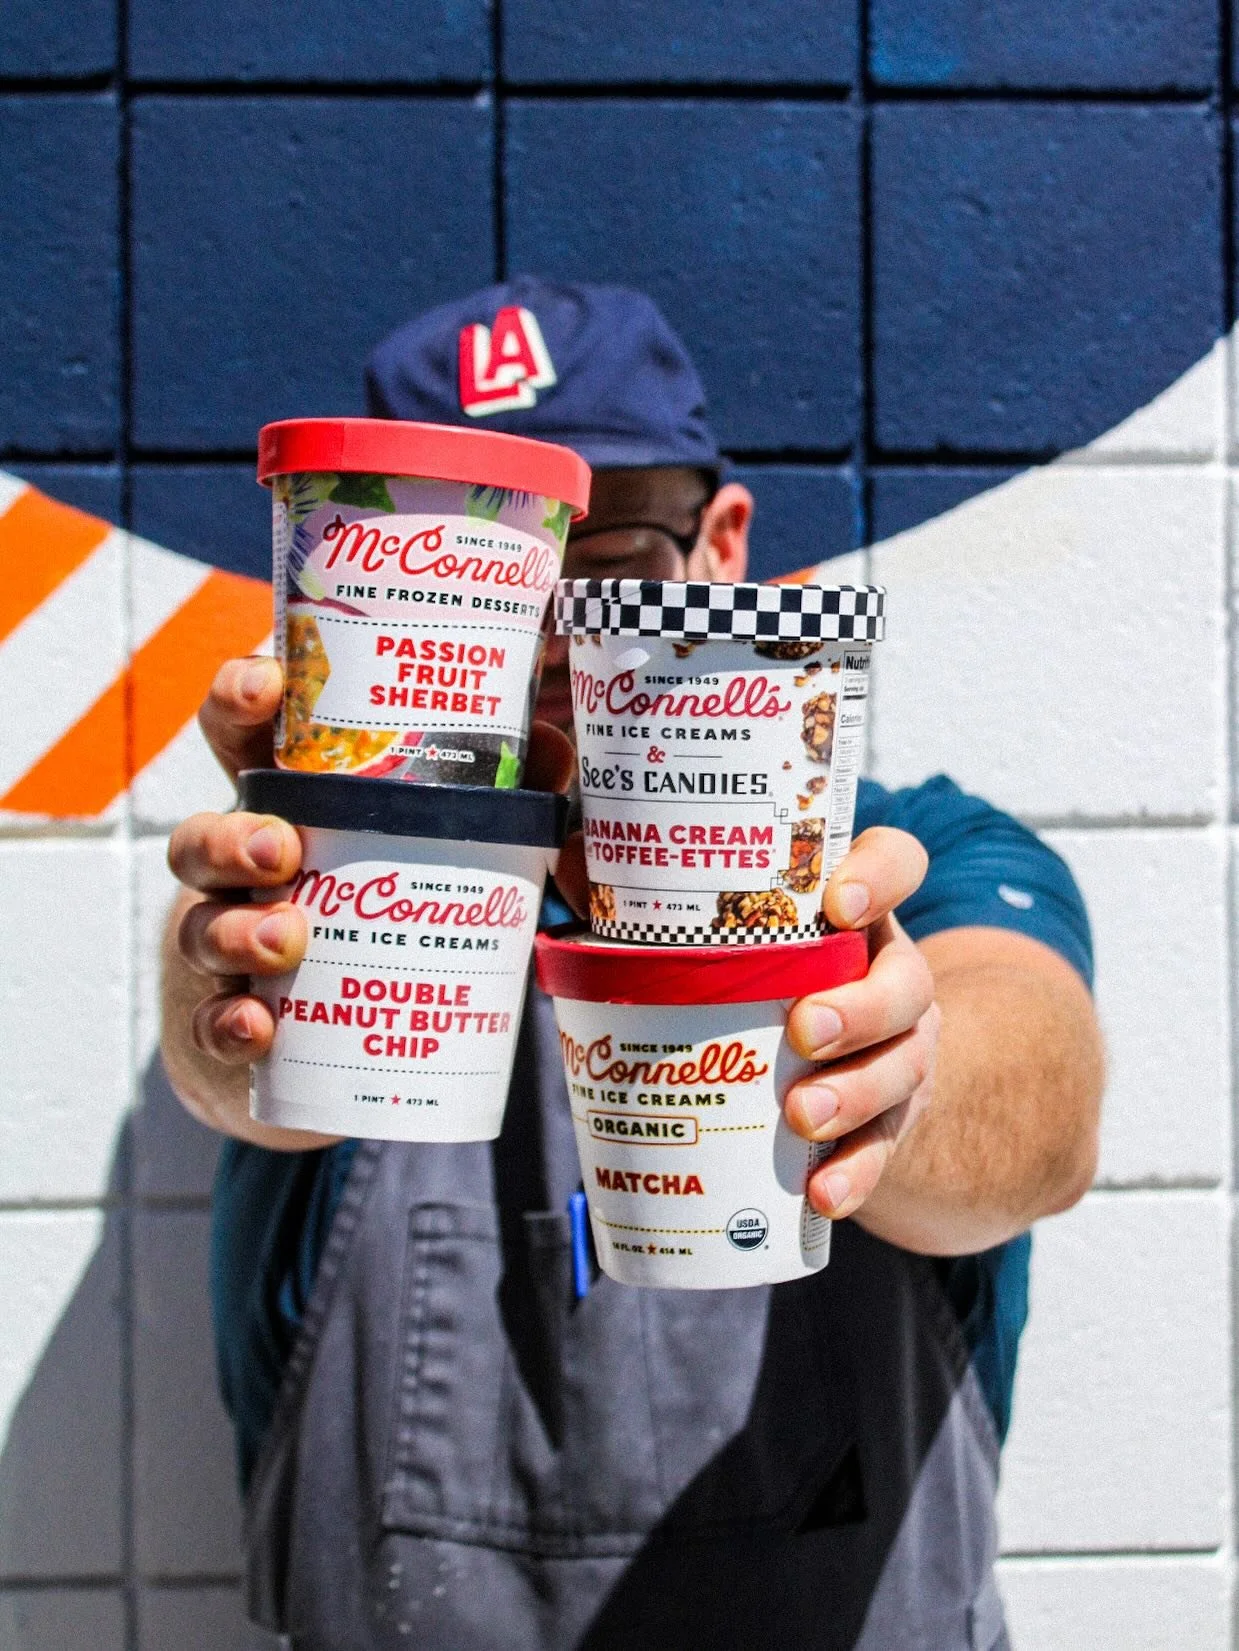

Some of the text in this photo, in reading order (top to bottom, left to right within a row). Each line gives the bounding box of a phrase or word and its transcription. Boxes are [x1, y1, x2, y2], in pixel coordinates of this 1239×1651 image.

[459, 305, 557, 417] LA
[323, 514, 554, 593] McConnell's
[456, 535, 522, 553] SINCE 1949
[336, 584, 541, 618] FINE FROZEN DESSERTS
[376, 636, 506, 669] PASSION
[398, 663, 488, 690] FRUIT
[644, 676, 719, 686] SINCE 1949
[369, 684, 502, 716] SHERBET
[572, 665, 792, 718] McConnell's
[586, 723, 751, 741] FINE ICE CREAMS
[399, 747, 422, 755] PINT
[442, 751, 457, 759] 473
[647, 745, 666, 764] &
[582, 756, 768, 795] See's CANDIES
[669, 825, 773, 845] CREAM
[593, 842, 770, 868] TOFFEE-ETTES
[286, 868, 527, 928] McConnell's
[410, 881, 484, 895] SINCE 1949
[629, 900, 647, 909] PINT
[666, 903, 683, 911] 473
[313, 926, 500, 951] FINE ICE CREAMS
[341, 977, 471, 1007] DOUBLE
[279, 996, 511, 1033] PEANUT BUTTER
[362, 1034, 440, 1059] CHIP
[560, 1031, 768, 1085] McConnell's
[620, 1042, 693, 1053] SINCE 1949
[362, 1095, 385, 1104] PINT
[406, 1097, 423, 1106] 473
[426, 1099, 439, 1107] ML
[601, 1089, 628, 1104] ICE
[637, 1093, 726, 1106] CREAMS
[593, 1117, 685, 1138] ORGANIC
[595, 1167, 704, 1195] MATCHA
[732, 1231, 763, 1240] ORGANIC
[737, 1218, 760, 1228] USDA
